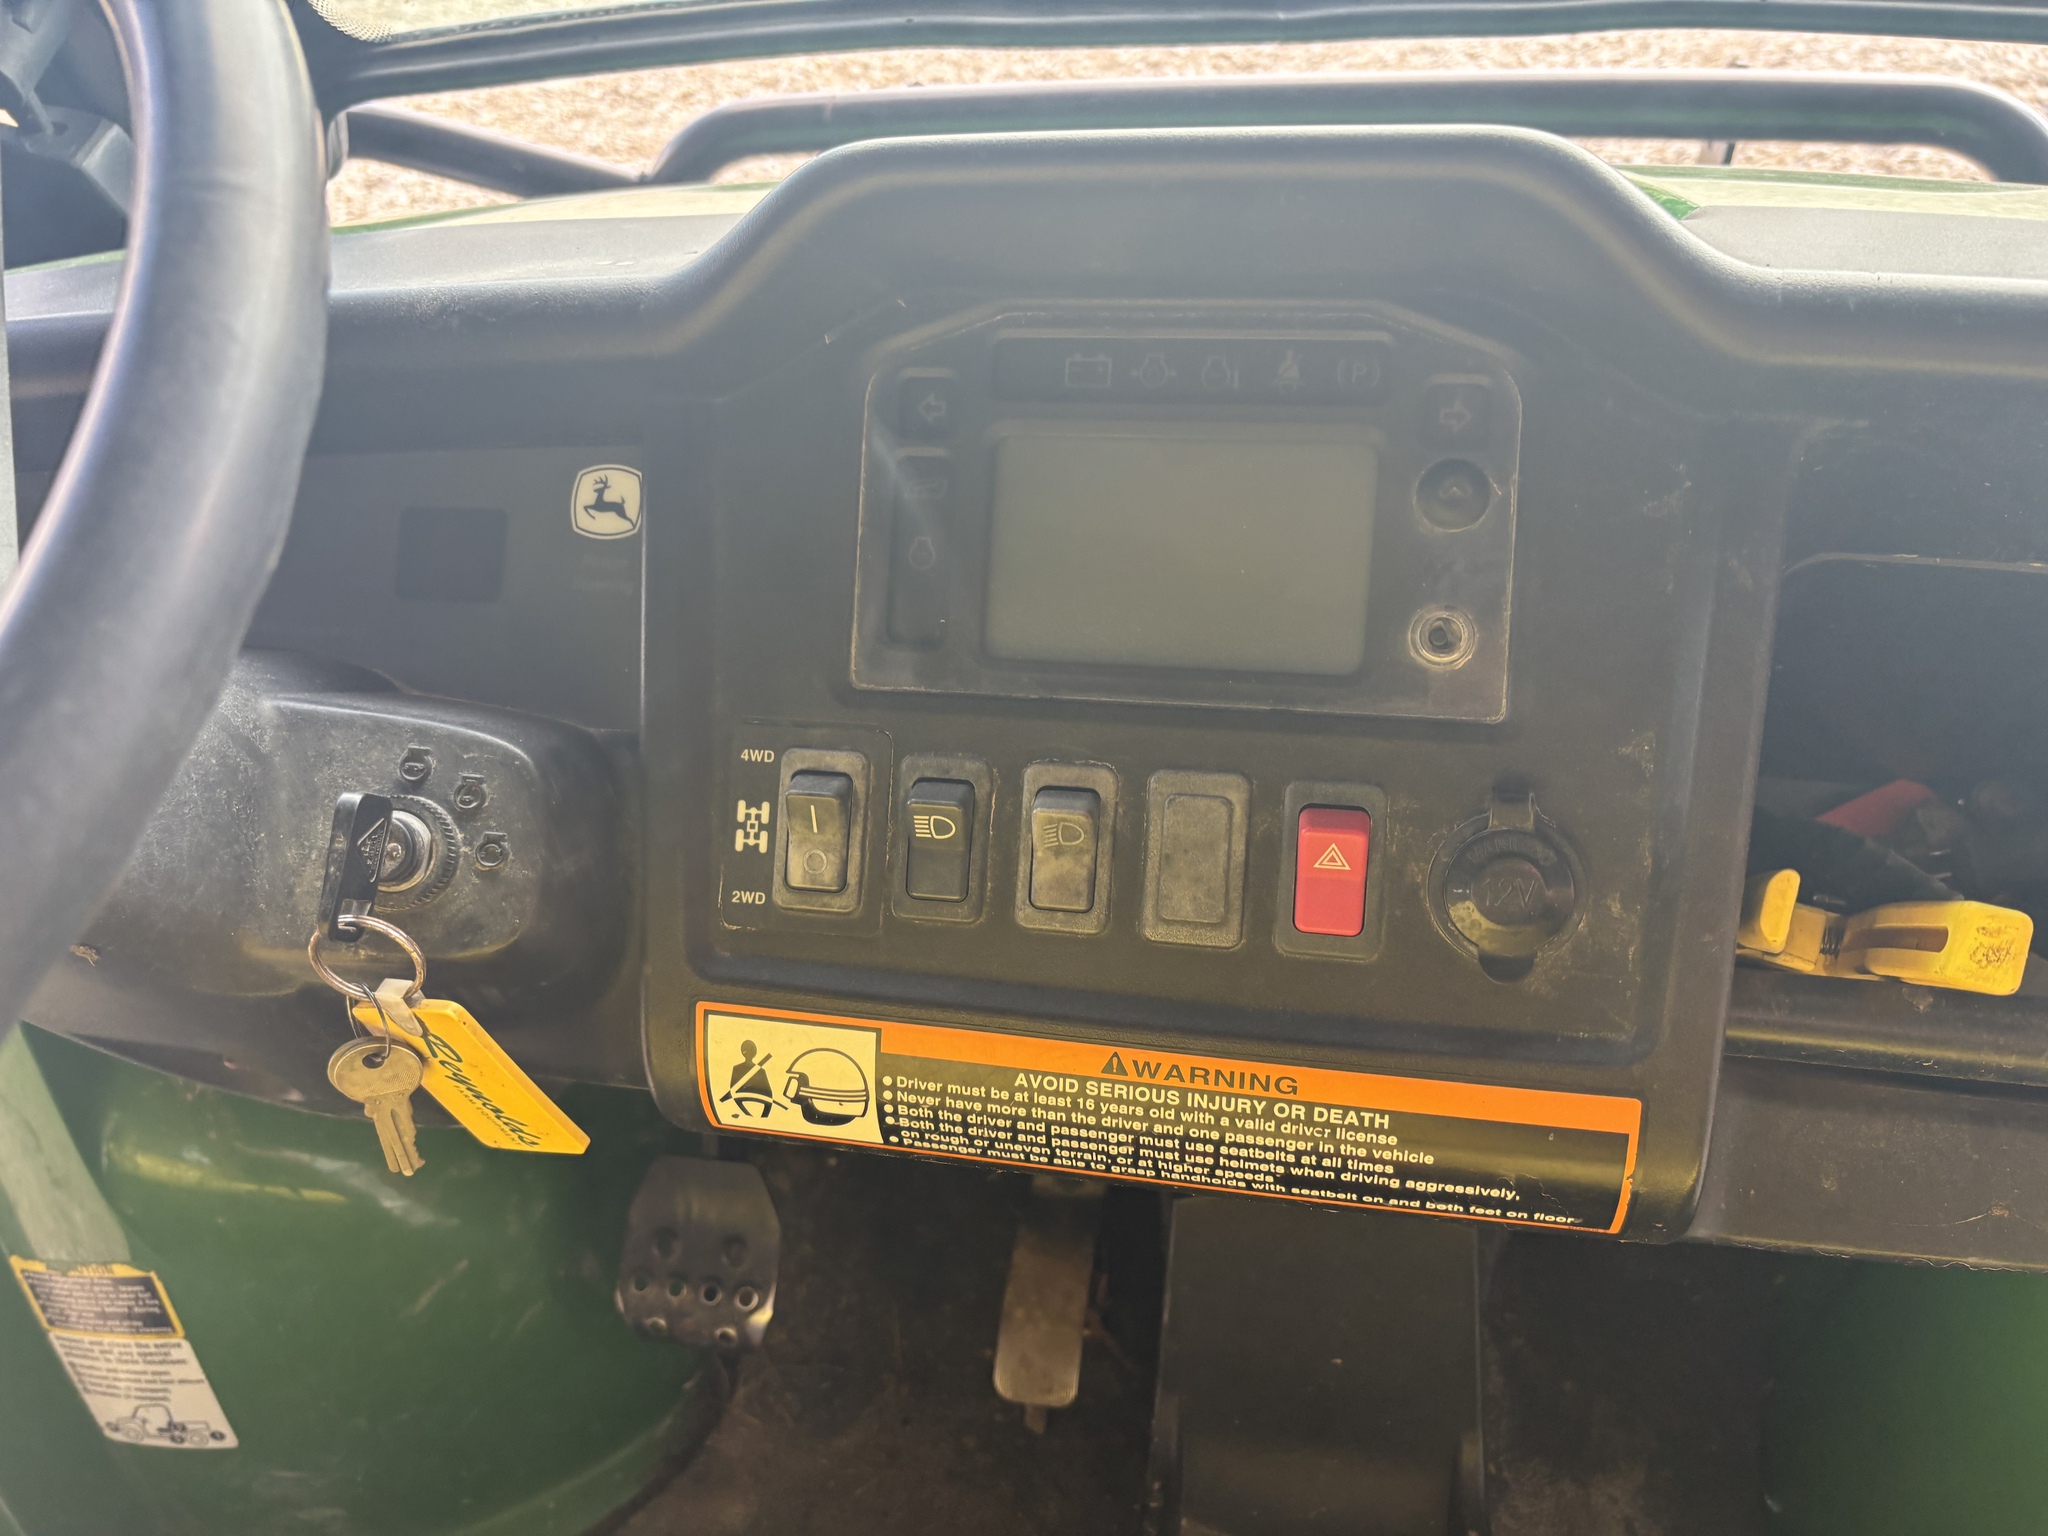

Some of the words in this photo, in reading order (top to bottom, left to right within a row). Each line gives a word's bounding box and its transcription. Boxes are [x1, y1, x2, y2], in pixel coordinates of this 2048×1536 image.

[740, 749, 775, 763] 4WD
[731, 890, 766, 905] 2WD
[1481, 878, 1539, 909] 12V
[1014, 1073, 1079, 1093] AVOID
[1086, 1081, 1180, 1105] SERIOUS
[1187, 1092, 1267, 1115] INJURY
[1273, 1102, 1305, 1120] OR
[1314, 1107, 1390, 1129] DEATH
[1132, 1059, 1298, 1095] WARNING
[896, 1076, 942, 1092] Driver
[947, 1085, 986, 1097] must
[991, 1087, 1010, 1100] be
[1014, 1091, 1029, 1103] at
[1033, 1092, 1072, 1108] least
[1077, 1098, 1095, 1110] 16
[1101, 1101, 1144, 1117] years
[1149, 1107, 1175, 1120] old
[1180, 1110, 1215, 1125] with
[1220, 1116, 1230, 1126] a
[1235, 1118, 1276, 1132] valid
[1336, 1127, 1398, 1146] license
[897, 1090, 941, 1106] Never
[945, 1096, 982, 1111] have
[987, 1103, 1027, 1117] more
[1031, 1107, 1066, 1121] than
[1071, 1112, 1096, 1126] the
[1101, 1116, 1149, 1131] driver
[1153, 1125, 1184, 1136] and
[1189, 1128, 1220, 1140] one
[1225, 1132, 1314, 1151] passenger
[1318, 1141, 1334, 1154] in
[1339, 1144, 1367, 1157] the
[1372, 1149, 1434, 1164] vehicle
[898, 1104, 933, 1119] Both
[937, 1109, 962, 1122] the
[966, 1113, 1012, 1128] driver
[1016, 1121, 1045, 1132] and
[1051, 1125, 1135, 1143] passenger
[1139, 1135, 1180, 1149] must
[1185, 1141, 1214, 1153] use
[1219, 1145, 1296, 1163] seatbelts
[1300, 1154, 1317, 1165] at
[1321, 1157, 1341, 1168] all
[1346, 1159, 1394, 1174] times
[899, 1117, 935, 1131] Both
[938, 1122, 963, 1134] the
[968, 1126, 1013, 1140] driver
[1017, 1133, 1046, 1144] and
[1051, 1138, 1135, 1155] passenger
[1139, 1148, 1180, 1161] must
[1184, 1154, 1214, 1165] use
[1219, 1157, 1285, 1174] helmets
[1290, 1166, 1335, 1180] when
[1340, 1172, 1400, 1189] driving
[1405, 1179, 1520, 1201] aggressively,
[901, 1130, 920, 1139] on
[924, 1132, 969, 1145] rough
[974, 1139, 990, 1148] or
[994, 1142, 1050, 1155] uneven
[1055, 1148, 1112, 1164] terrain,
[1116, 1157, 1133, 1166] or
[1138, 1158, 1153, 1168] at
[1158, 1160, 1210, 1175] higher
[1215, 1169, 1274, 1183] speeds
[903, 1138, 982, 1155] Passenger
[987, 1149, 1025, 1160] must
[1029, 1154, 1048, 1163] be
[1053, 1158, 1086, 1168] able
[1090, 1161, 1106, 1170] to
[1111, 1164, 1156, 1177] grasp
[1161, 1169, 1246, 1188] handholds
[1251, 1182, 1286, 1192] with
[1291, 1187, 1358, 1200] seatbelt
[1362, 1195, 1383, 1204] on
[1388, 1198, 1420, 1208] and
[1425, 1201, 1464, 1212] both
[1469, 1205, 1502, 1216] feet
[1506, 1210, 1528, 1219] on
